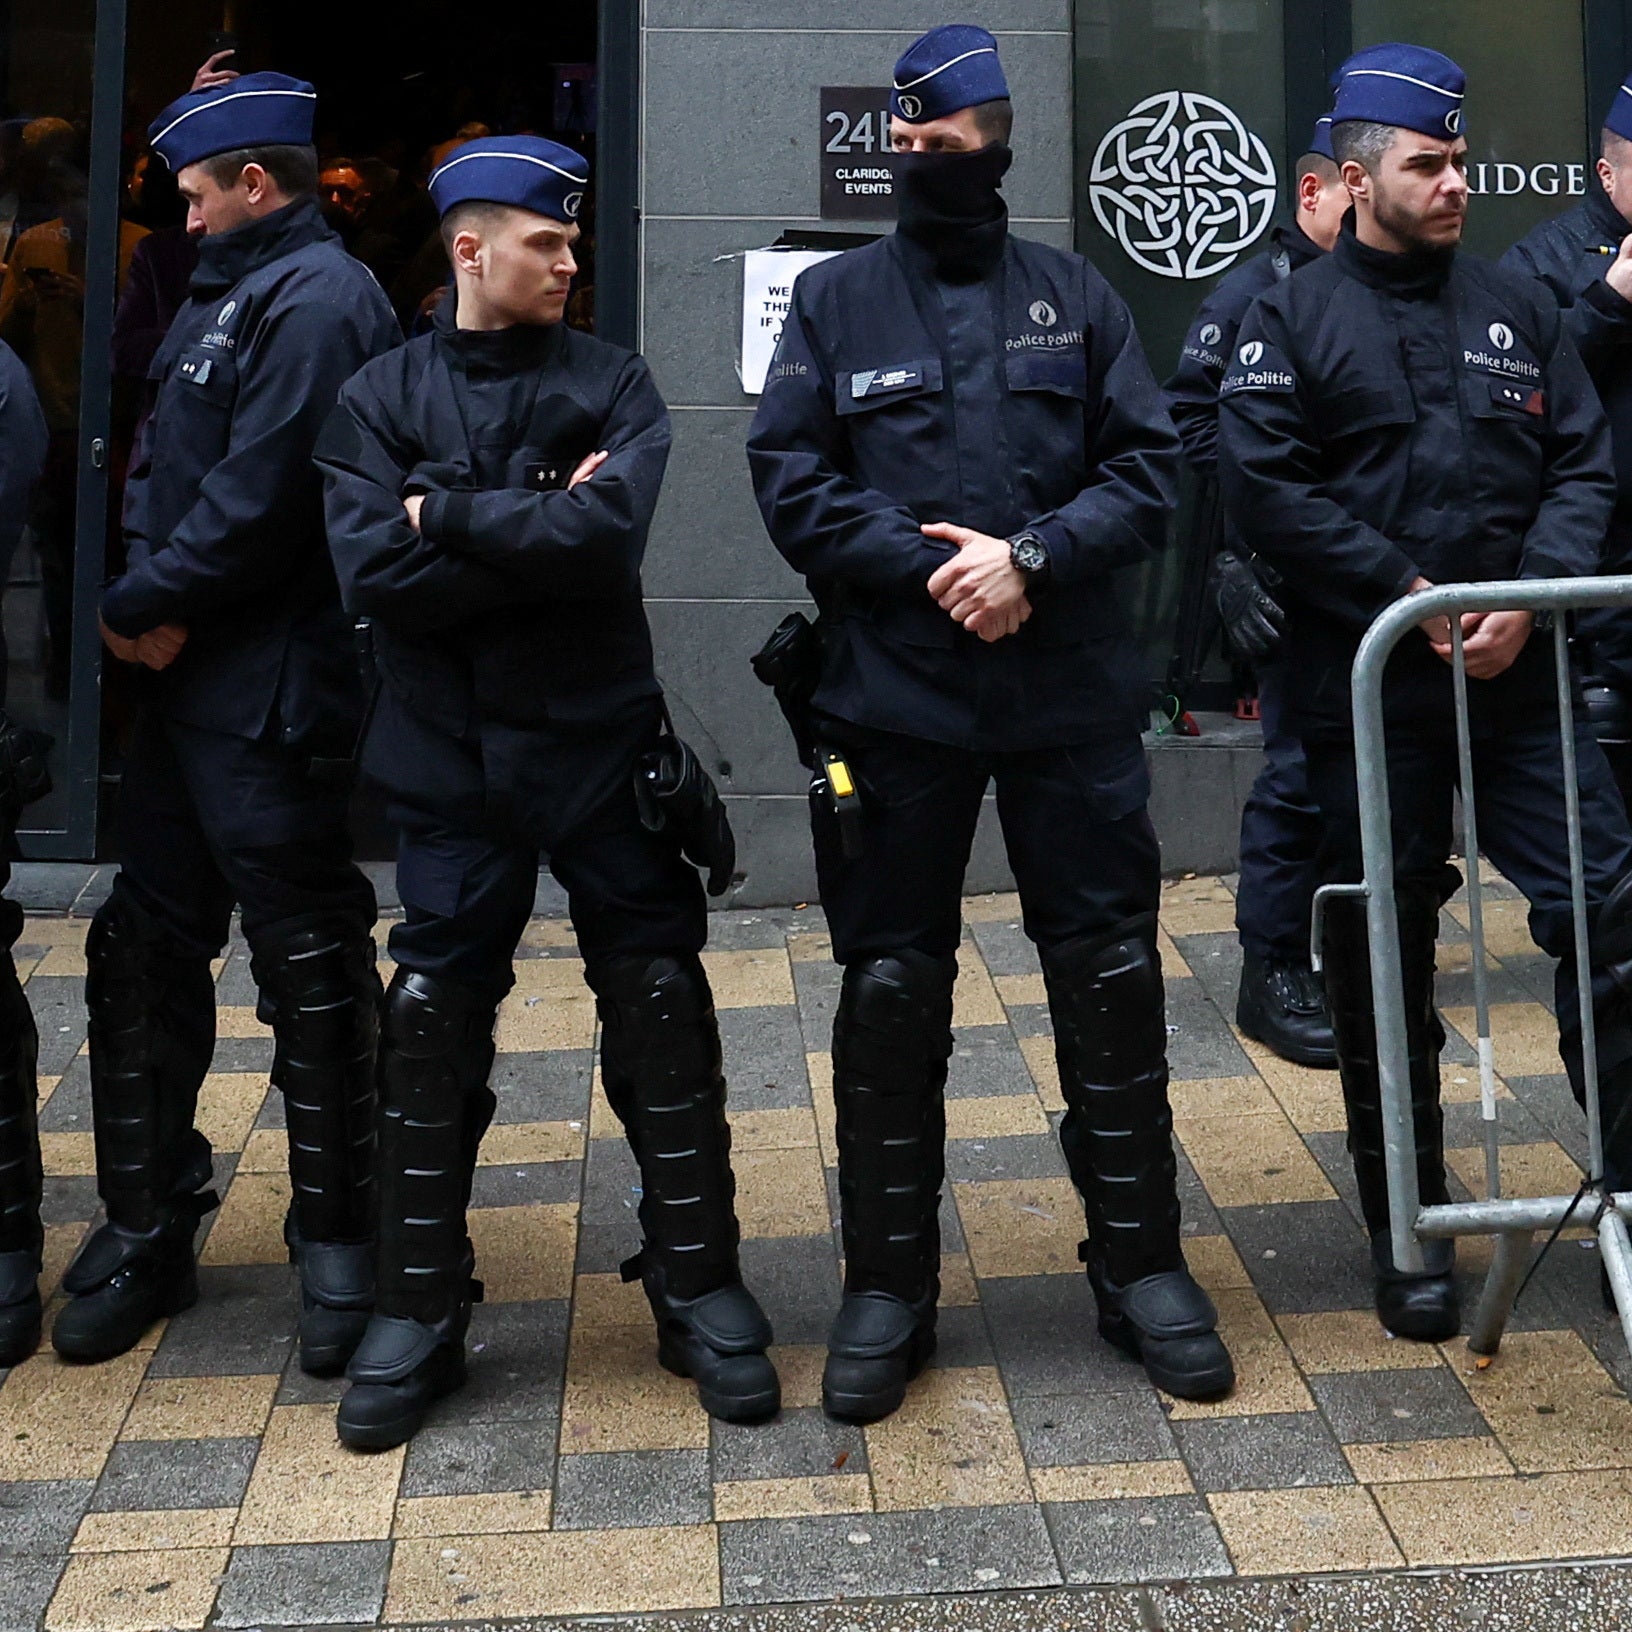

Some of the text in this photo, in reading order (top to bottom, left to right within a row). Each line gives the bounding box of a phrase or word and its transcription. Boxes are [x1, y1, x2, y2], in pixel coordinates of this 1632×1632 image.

[835, 169, 893, 180] CLARIDG
[845, 183, 892, 194] EVENTS
[768, 286, 790, 296] WE
[761, 317, 773, 327] IF
[1005, 333, 1045, 351] Police
[1464, 350, 1540, 378] Police Politie
[1247, 371, 1292, 385] Politie
